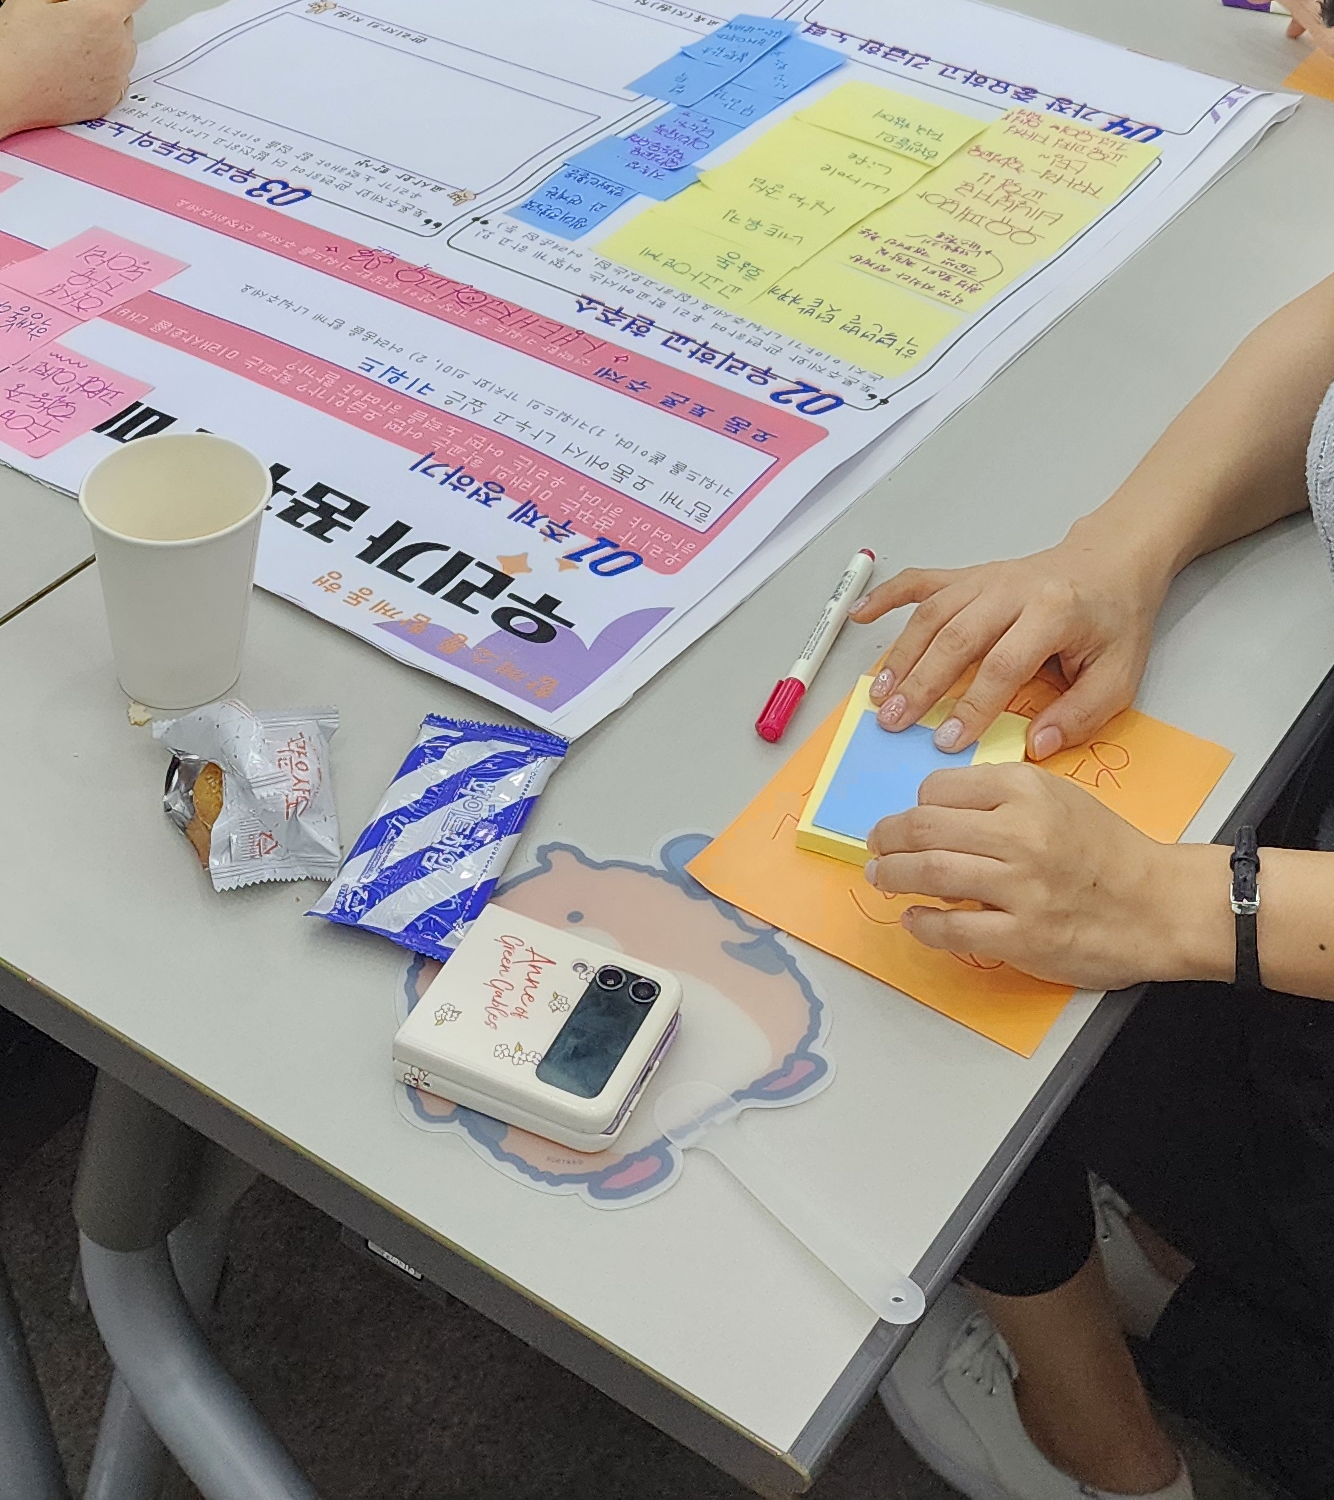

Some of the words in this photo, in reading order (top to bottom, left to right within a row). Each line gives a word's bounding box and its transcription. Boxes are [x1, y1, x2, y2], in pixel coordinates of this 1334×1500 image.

[331, 9, 367, 24] 지원
[364, 18, 430, 45] 관리자의
[798, 21, 854, 45] 노력
[854, 37, 936, 70] 긴급한
[934, 61, 1043, 103] 중요하고
[146, 98, 218, 130] 나눠주세요
[1040, 94, 1106, 123] 가장
[125, 128, 209, 167] 모두의
[214, 122, 263, 145] 이야기
[199, 155, 264, 187] 우리
[268, 156, 291, 168] 더
[286, 161, 354, 193] 관련하여
[310, 155, 378, 186] 노력해야
[353, 156, 394, 175] 학생
[240, 174, 316, 212] 03
[373, 178, 425, 202] 우리가
[393, 170, 446, 194] 교사와
[352, 184, 430, 220] 토론주제와
[495, 236, 531, 253] 하고
[529, 248, 584, 274] 어떻게
[236, 281, 310, 318] 나눠주세요
[584, 270, 669, 309] 학교에서는
[309, 310, 348, 330] 함께
[562, 290, 662, 340] 현주소
[671, 305, 707, 323] 우리
[145, 315, 241, 366] 미래사회를
[344, 324, 407, 356] 어려움을
[708, 320, 784, 356] 관련하여
[785, 338, 844, 365] 이야기
[237, 351, 302, 386] 학교는
[284, 356, 342, 387] 할까?
[406, 350, 429, 363] 2)
[427, 358, 471, 381] 의미,
[653, 326, 784, 390] 우리학교
[785, 352, 877, 394] 토론주제와
[351, 353, 440, 399] 키워드
[467, 374, 524, 404] 가치와
[590, 363, 654, 396] 주제
[292, 376, 386, 425] 모습인가?
[338, 380, 405, 415] 하여야
[436, 387, 490, 417] 싶은
[656, 389, 717, 421] 토론
[764, 375, 848, 422] 02
[379, 415, 428, 443] 어떤
[402, 407, 466, 442] 노력을
[487, 407, 560, 446] 나누고
[717, 413, 781, 447] 모둠
[422, 433, 490, 471] 학교는
[458, 433, 509, 461] 어떤
[604, 431, 669, 466] 붙이며,
[405, 449, 514, 510] 정하기
[483, 463, 557, 503] 미래의
[504, 453, 572, 490] 우리는
[555, 440, 659, 494] 모둠에서
[664, 459, 741, 499] 키워드를
[502, 498, 585, 547] 주제
[552, 497, 617, 533] 꿈꾸는
[652, 486, 720, 525] 함께
[614, 528, 686, 567] 우리가
[624, 514, 700, 555] 하여야
[560, 530, 649, 585] 01
[308, 564, 435, 639] 함께동행
[346, 515, 588, 655] 우리가
[524, 946, 557, 1005] Anne
